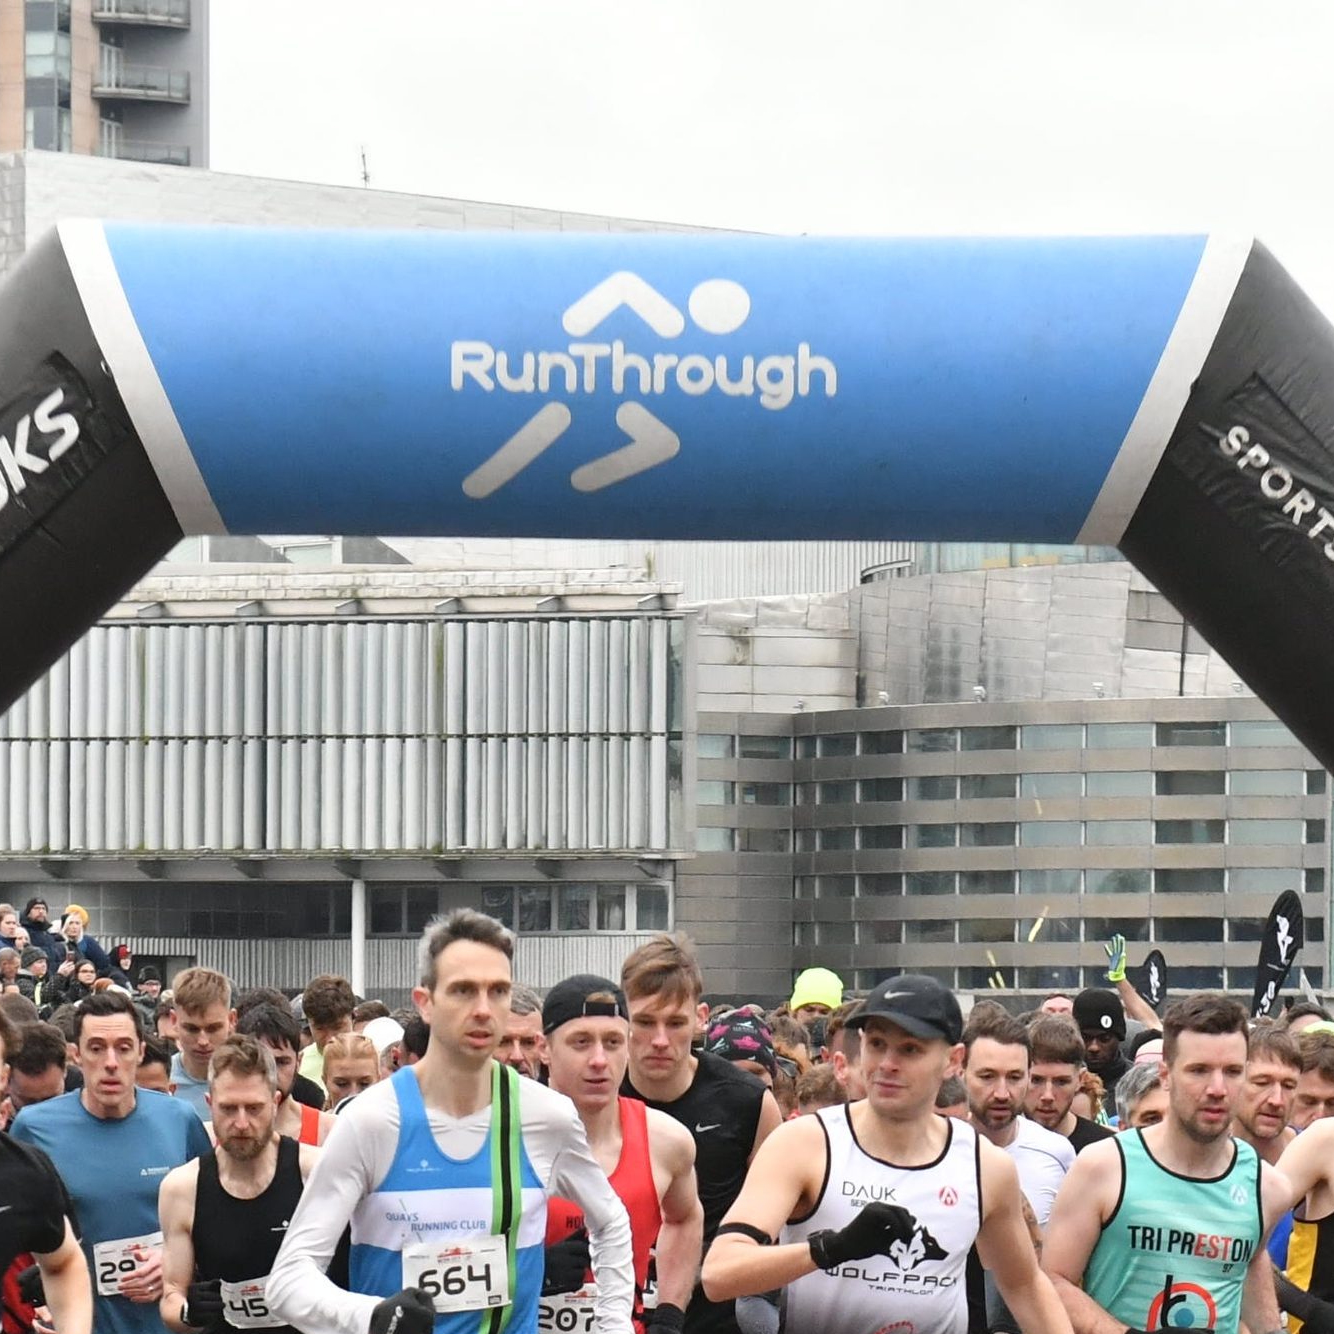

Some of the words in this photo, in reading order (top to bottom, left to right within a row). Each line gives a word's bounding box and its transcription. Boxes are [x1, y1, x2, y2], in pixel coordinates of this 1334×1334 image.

[450, 339, 837, 410] RunThrough
[411, 1220, 458, 1232] RUNNING
[460, 1219, 487, 1230] CLUB
[1127, 1225, 1162, 1251] TRI
[1167, 1229, 1253, 1263] PRESTON
[418, 1263, 492, 1298] 664
